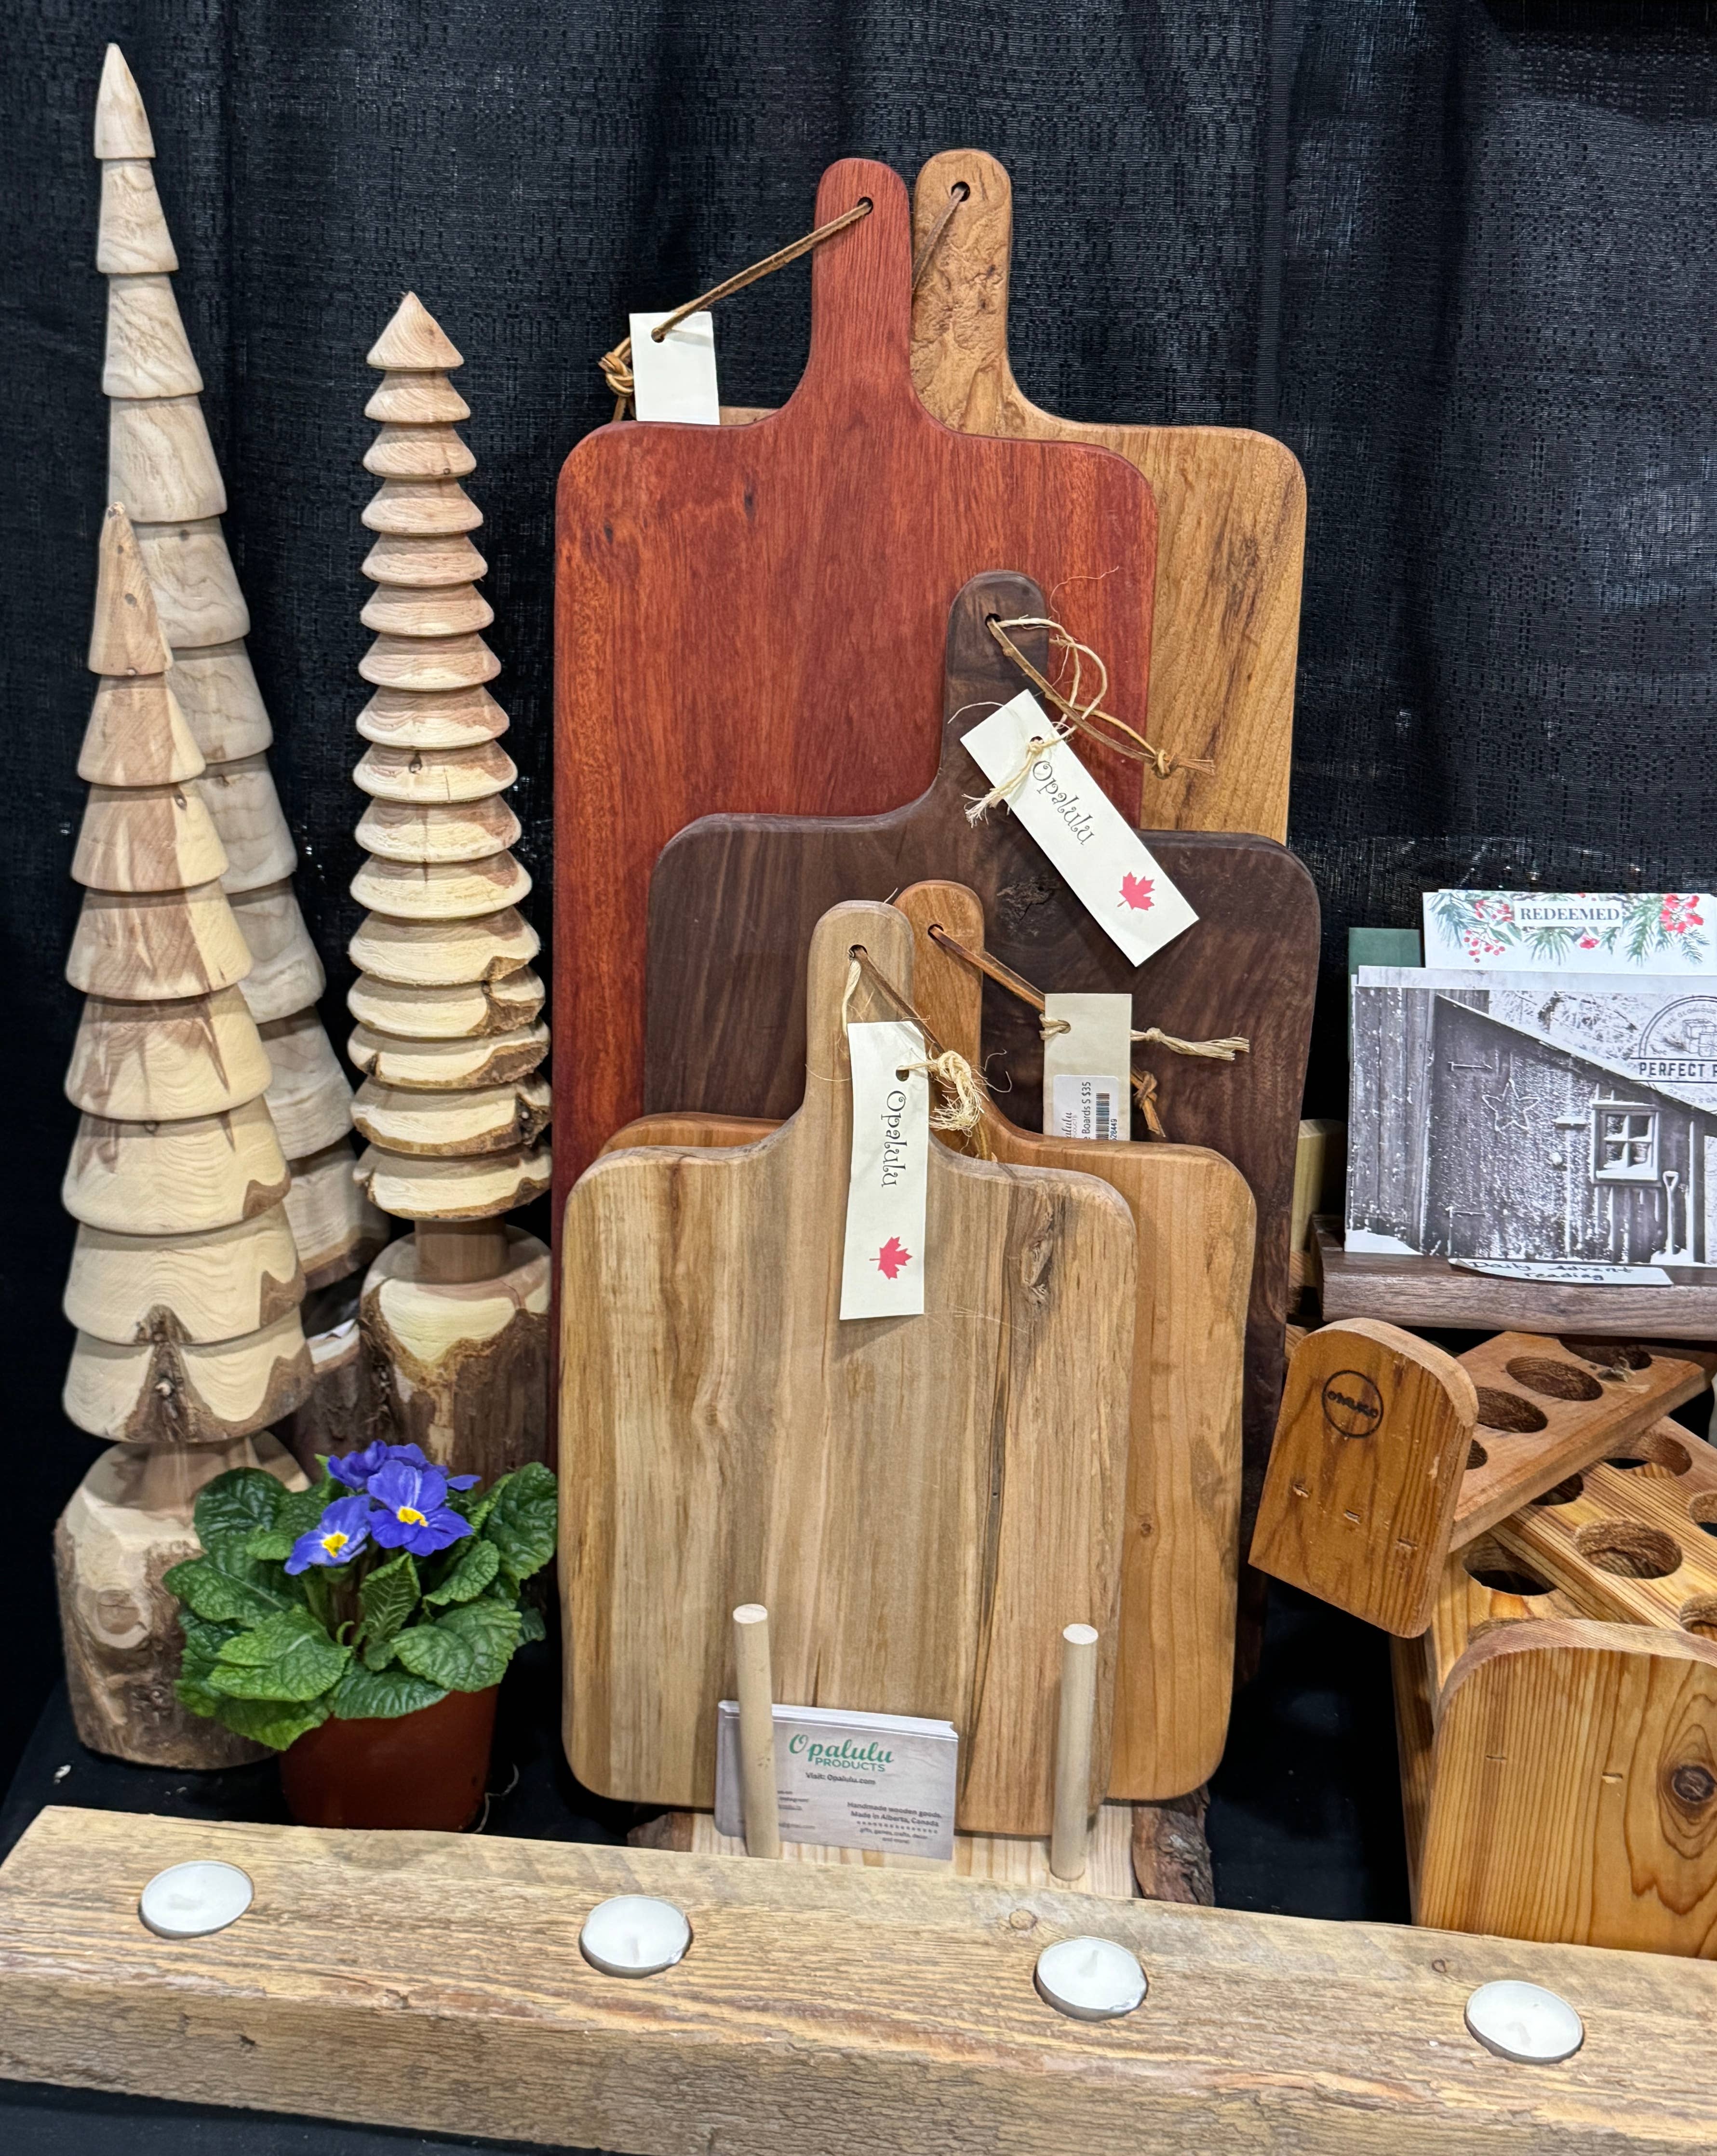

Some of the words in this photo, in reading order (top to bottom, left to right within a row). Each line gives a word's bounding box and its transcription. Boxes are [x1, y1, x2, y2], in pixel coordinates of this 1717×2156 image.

[1032, 760, 1096, 846] Opalulu
[1520, 908, 1620, 920] REDEEMED
[1639, 1062, 1706, 1078] PERFECT
[1081, 1081, 1091, 1096] $35
[1081, 1106, 1091, 1134] Boards
[880, 1090, 908, 1188] Opalulu
[1468, 1261, 1531, 1271] Daily
[1548, 1264, 1634, 1274] Advent
[789, 1734, 894, 1763] Opalulu
[815, 1757, 886, 1773] PRODUCTS
[827, 1774, 876, 1784] Opalulu.com
[847, 1802, 887, 1812] Handmade
[850, 1810, 871, 1819] Made
